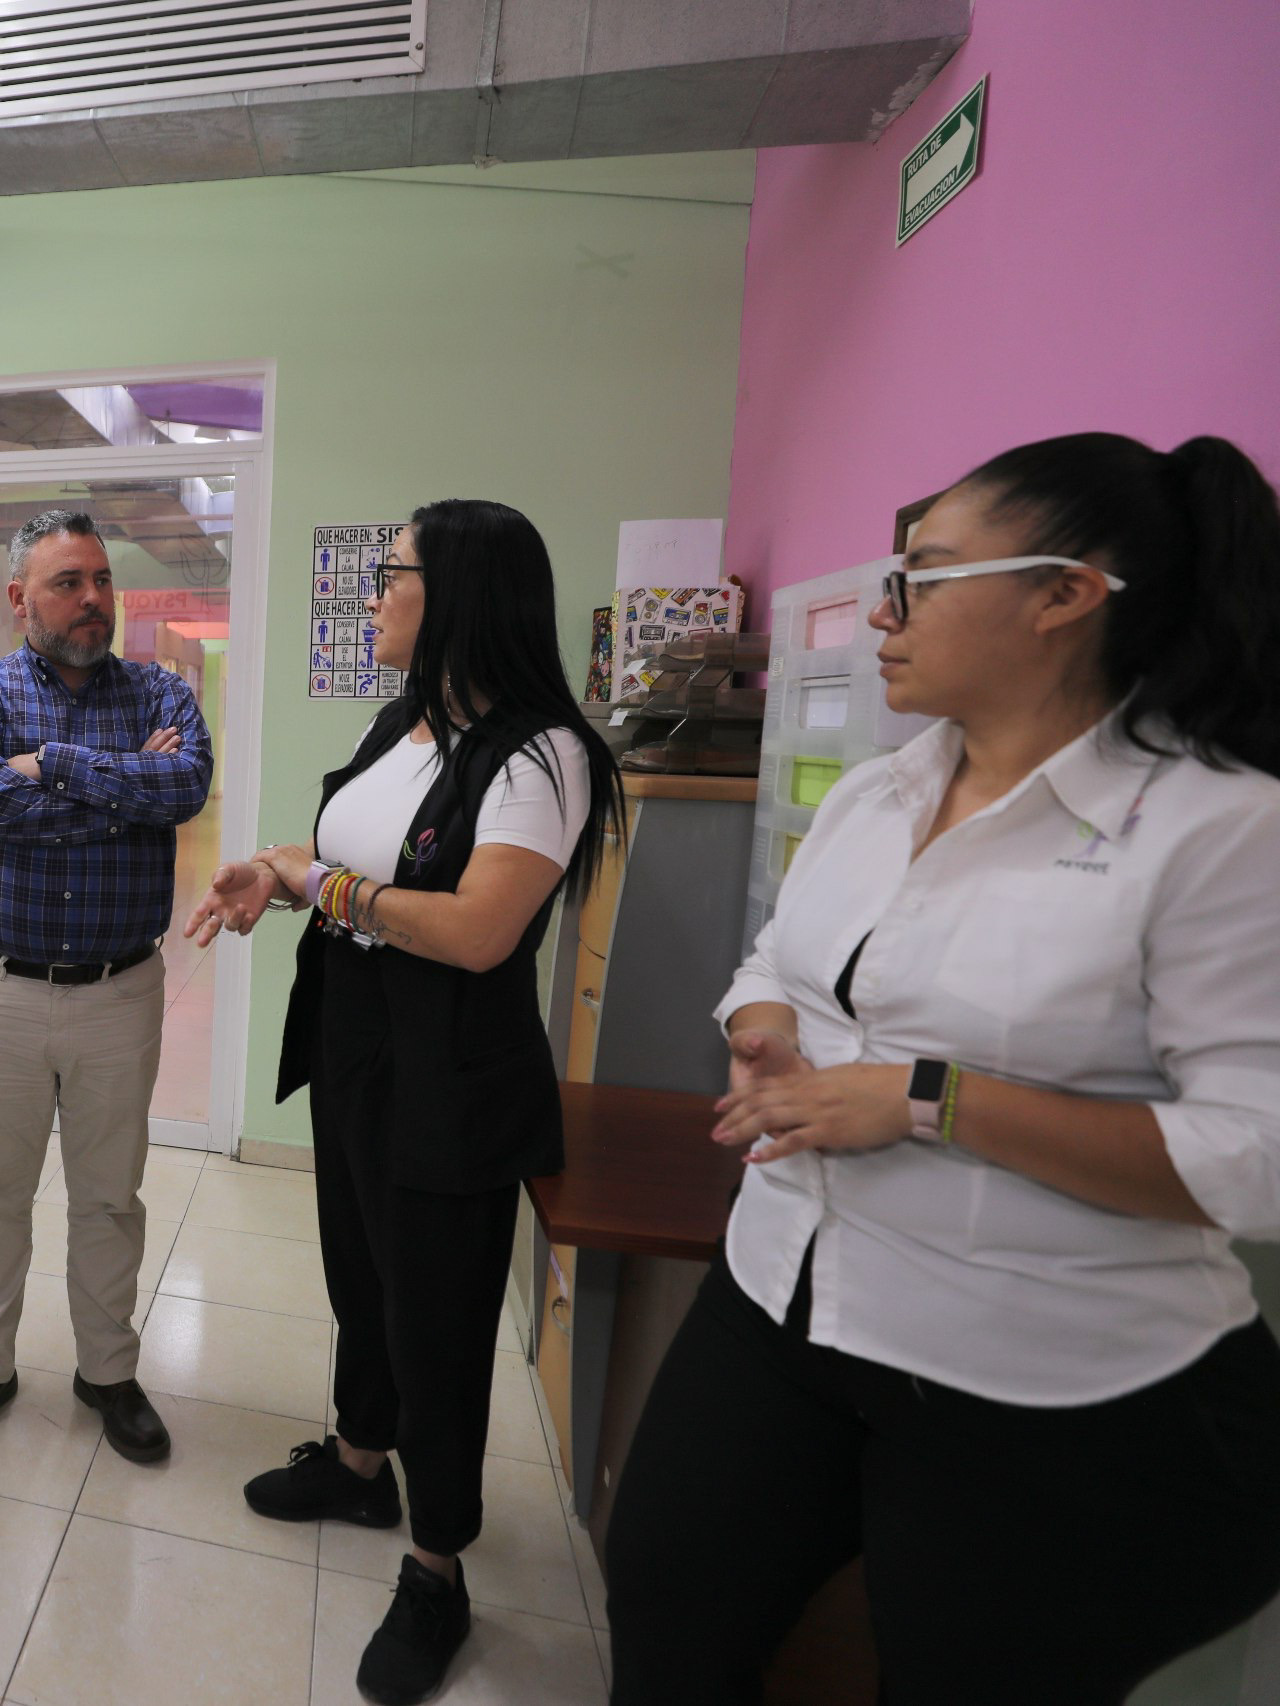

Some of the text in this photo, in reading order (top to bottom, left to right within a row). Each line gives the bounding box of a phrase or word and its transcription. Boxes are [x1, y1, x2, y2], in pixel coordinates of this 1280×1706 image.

[907, 133, 942, 179] RUTA DE
[904, 170, 955, 228] EVACUACION
[317, 529, 333, 545] QUE
[334, 528, 359, 544] HACER
[360, 528, 372, 543] EN:
[314, 601, 330, 617] QUE
[331, 601, 356, 616] HACER
[336, 620, 355, 628] CONSERVE
